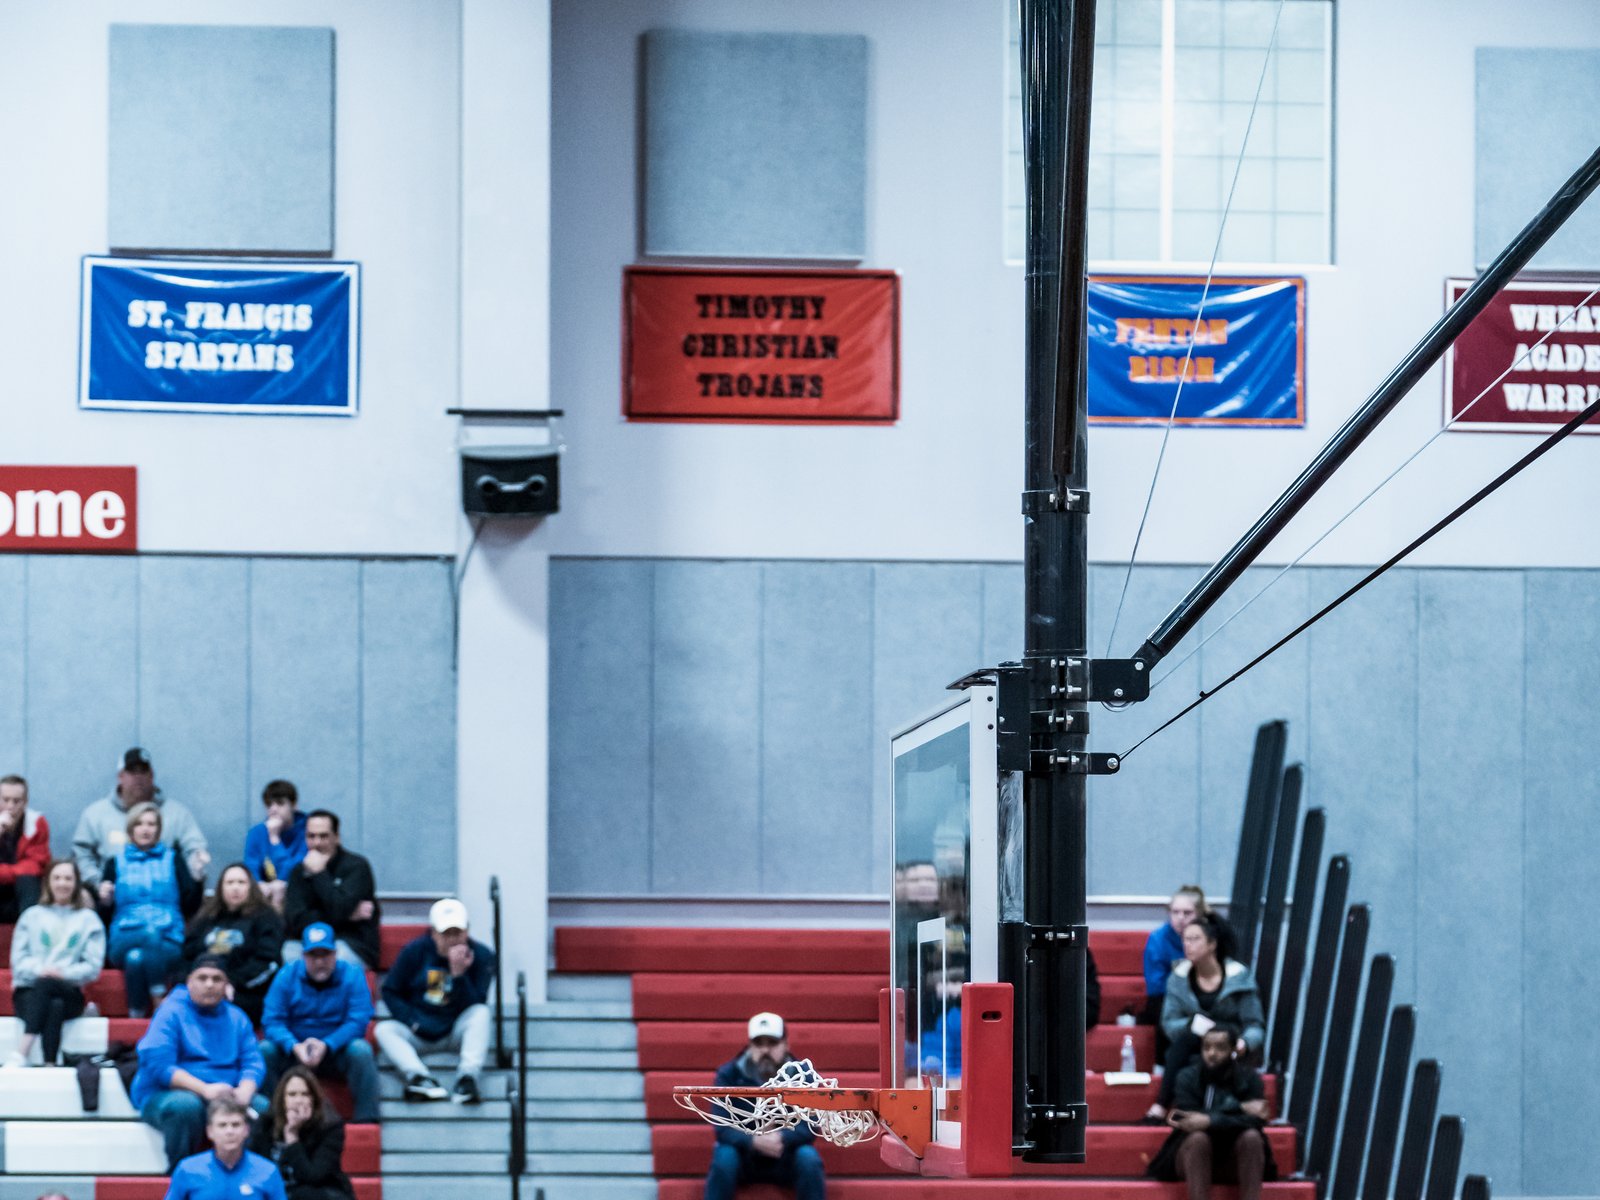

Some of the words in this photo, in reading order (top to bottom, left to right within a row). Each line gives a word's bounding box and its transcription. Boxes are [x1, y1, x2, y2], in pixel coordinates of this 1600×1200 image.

[128, 299, 174, 329] ST.
[185, 301, 312, 331] FRANCIS
[696, 294, 826, 320] TIMOTHY
[1116, 318, 1229, 344] FENTON
[145, 341, 294, 372] SPARTANS
[682, 334, 839, 359] CHRISTIAN
[1129, 356, 1214, 383] BISON
[697, 373, 823, 398] TROJANS
